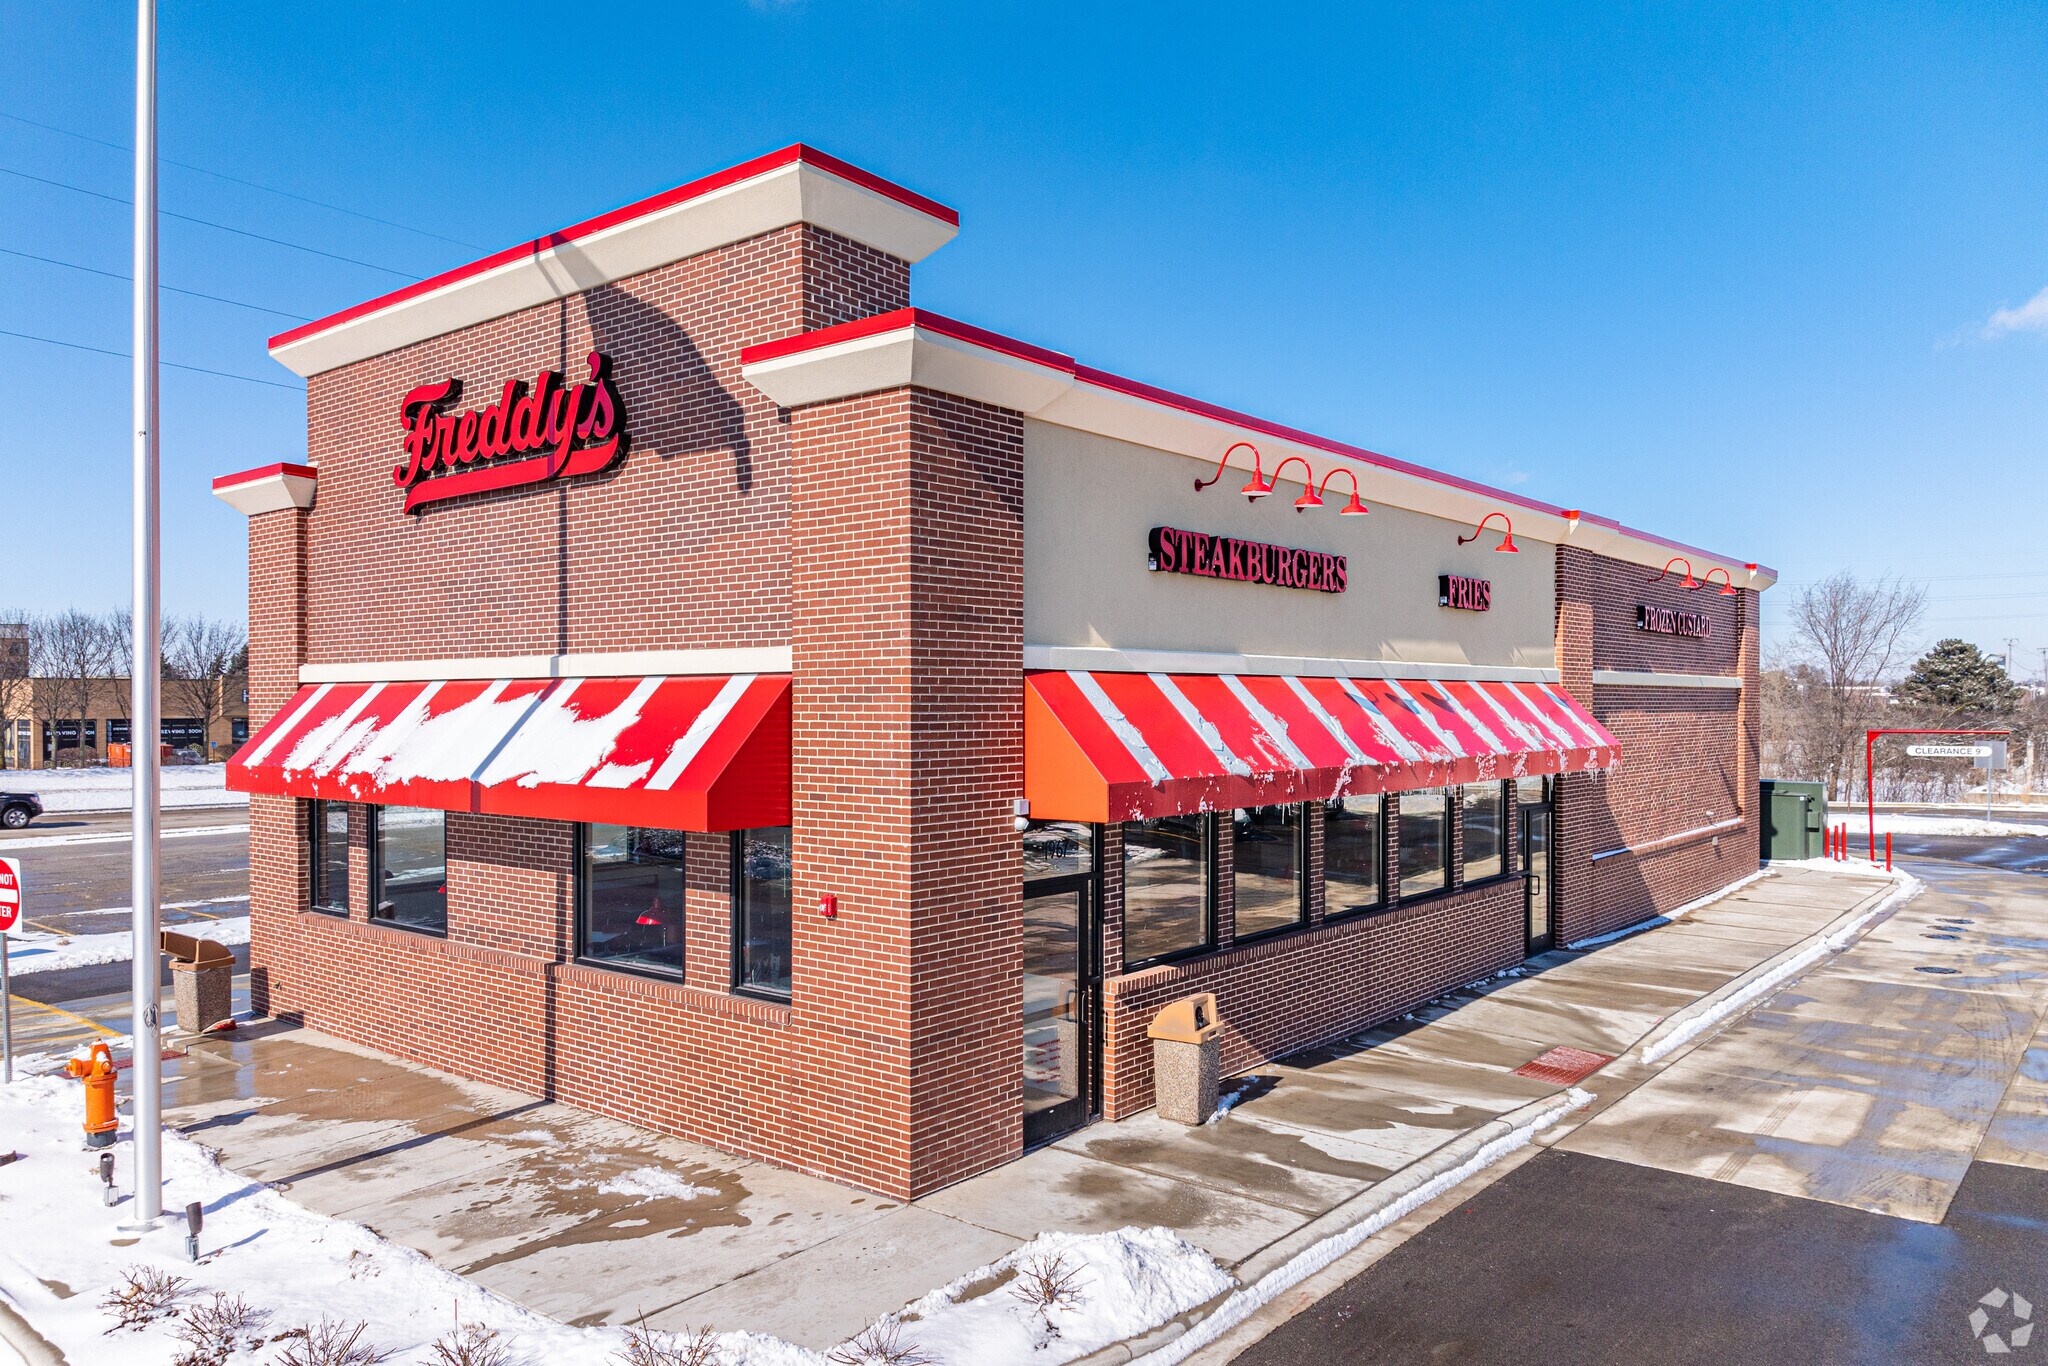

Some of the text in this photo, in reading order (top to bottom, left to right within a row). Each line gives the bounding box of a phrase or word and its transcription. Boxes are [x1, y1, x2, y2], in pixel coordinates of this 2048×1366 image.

[393, 351, 616, 514] Freddy's
[1159, 526, 1347, 593] STEAKBURGERS
[1447, 575, 1491, 611] FRIES
[1644, 606, 1711, 638] FROZEN CUSTARD
[1915, 747, 1973, 755] CLEARANCE
